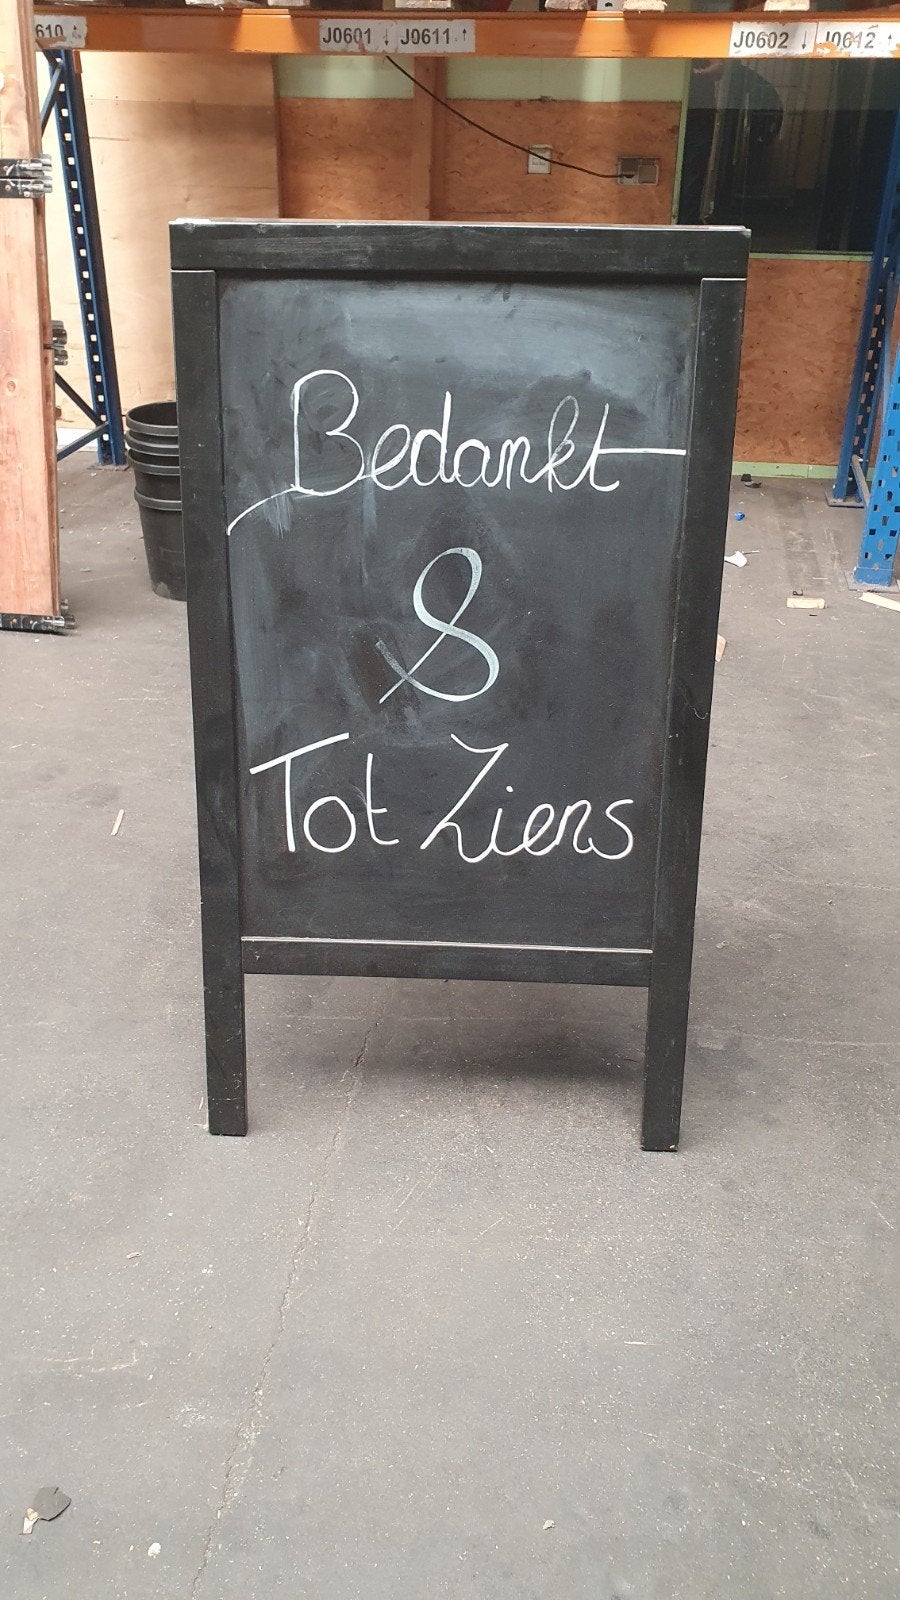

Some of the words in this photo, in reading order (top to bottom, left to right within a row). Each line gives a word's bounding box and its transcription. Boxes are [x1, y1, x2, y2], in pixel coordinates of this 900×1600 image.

[322, 27, 372, 44] J0601
[400, 27, 450, 45] J0611
[733, 31, 789, 49] J0602
[825, 31, 876, 49] J0612
[226, 368, 687, 536] Bedankt
[374, 546, 500, 704] &
[249, 732, 400, 853] Tot
[420, 733, 634, 863] Ziens
